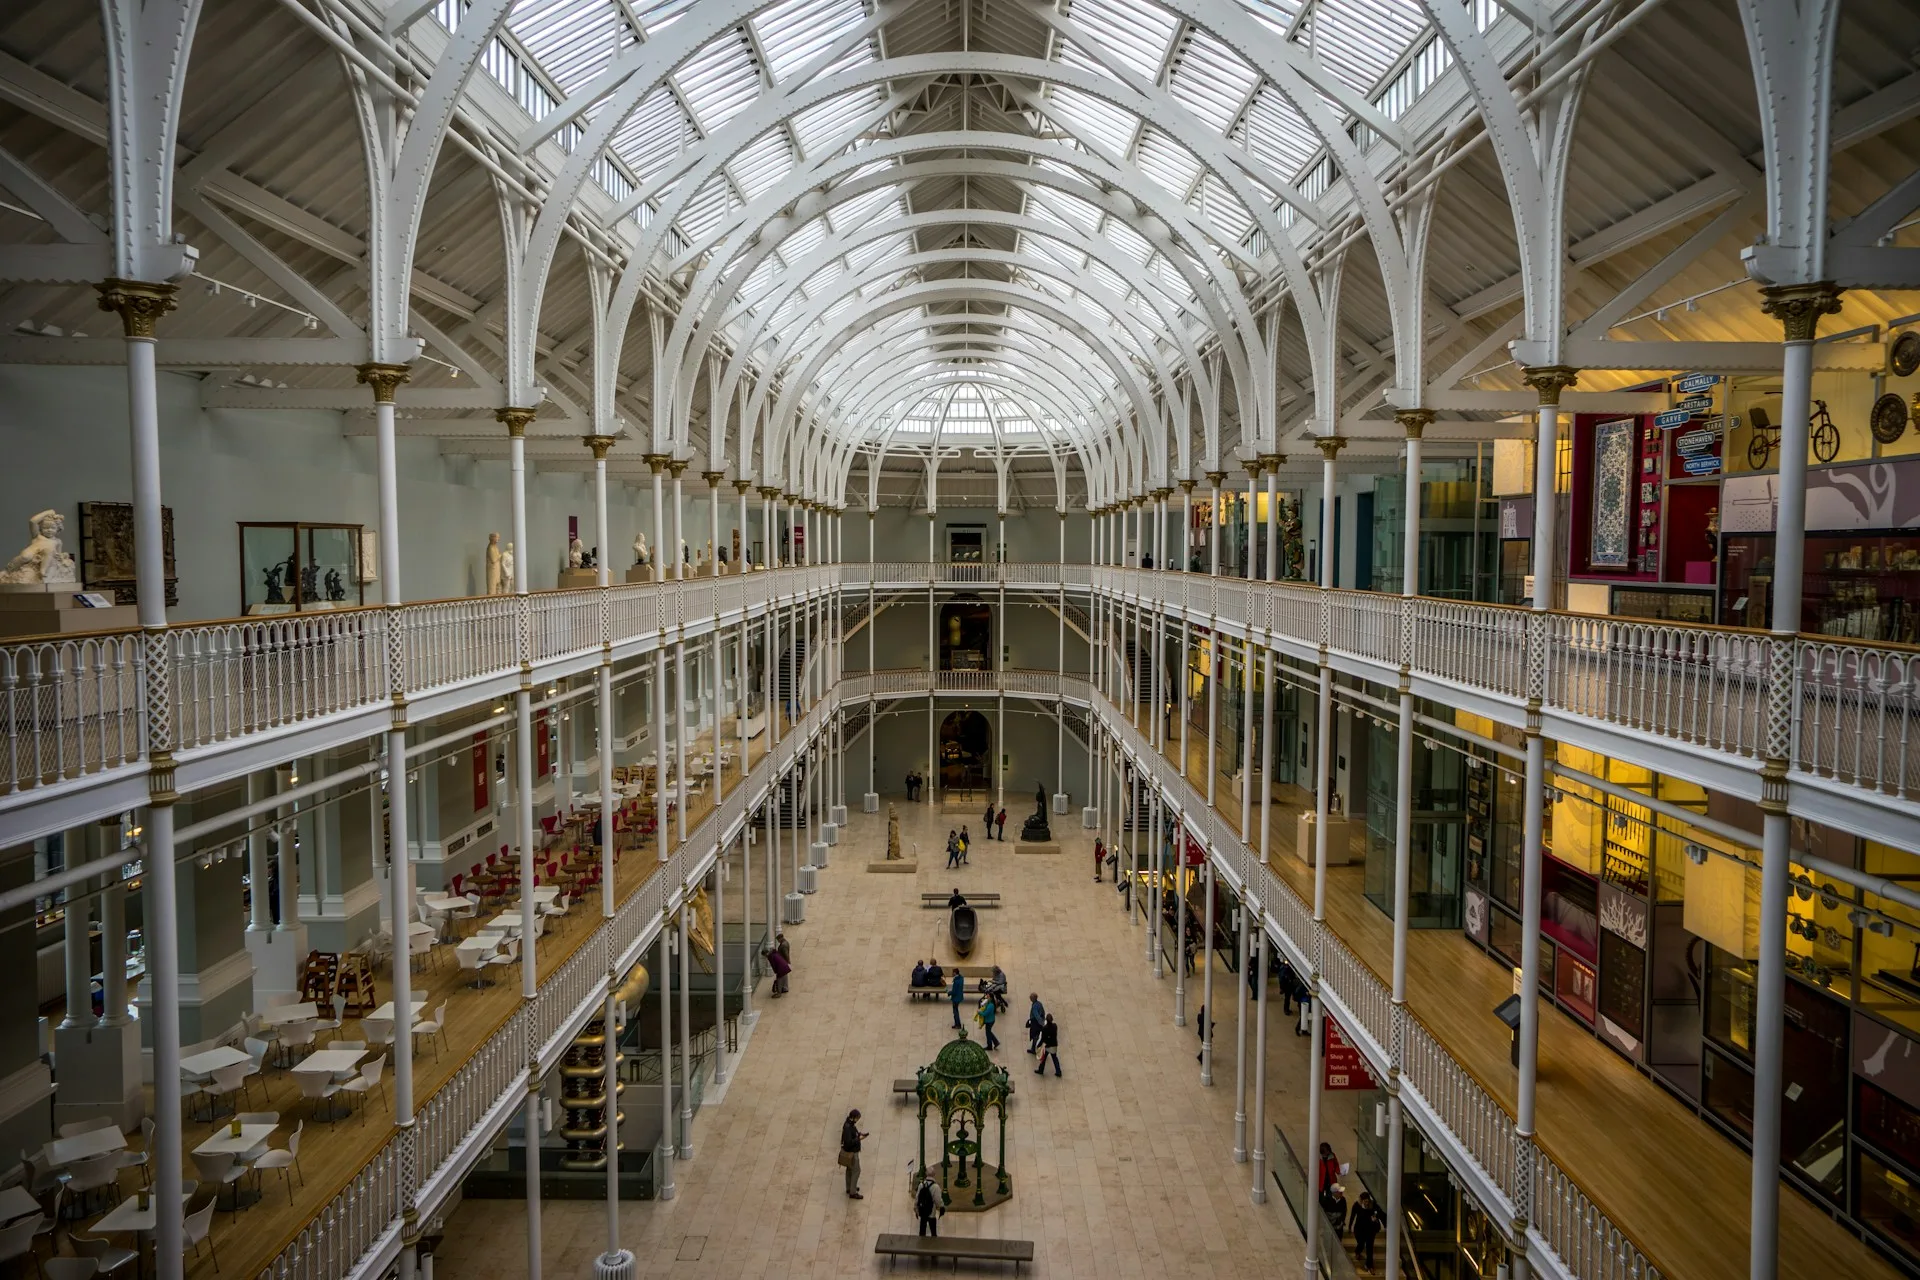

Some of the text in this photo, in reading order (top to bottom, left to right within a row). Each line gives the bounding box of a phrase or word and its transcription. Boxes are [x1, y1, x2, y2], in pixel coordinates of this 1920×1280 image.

[1684, 376, 1714, 388] DALMALLY
[1680, 399, 1709, 410] CARSTAIRS
[1661, 414, 1682, 424] GARVE
[1679, 434, 1713, 446] STONEHAVEN
[1685, 459, 1720, 469] NORTH BERWICK
[1331, 1076, 1346, 1084] Exit
